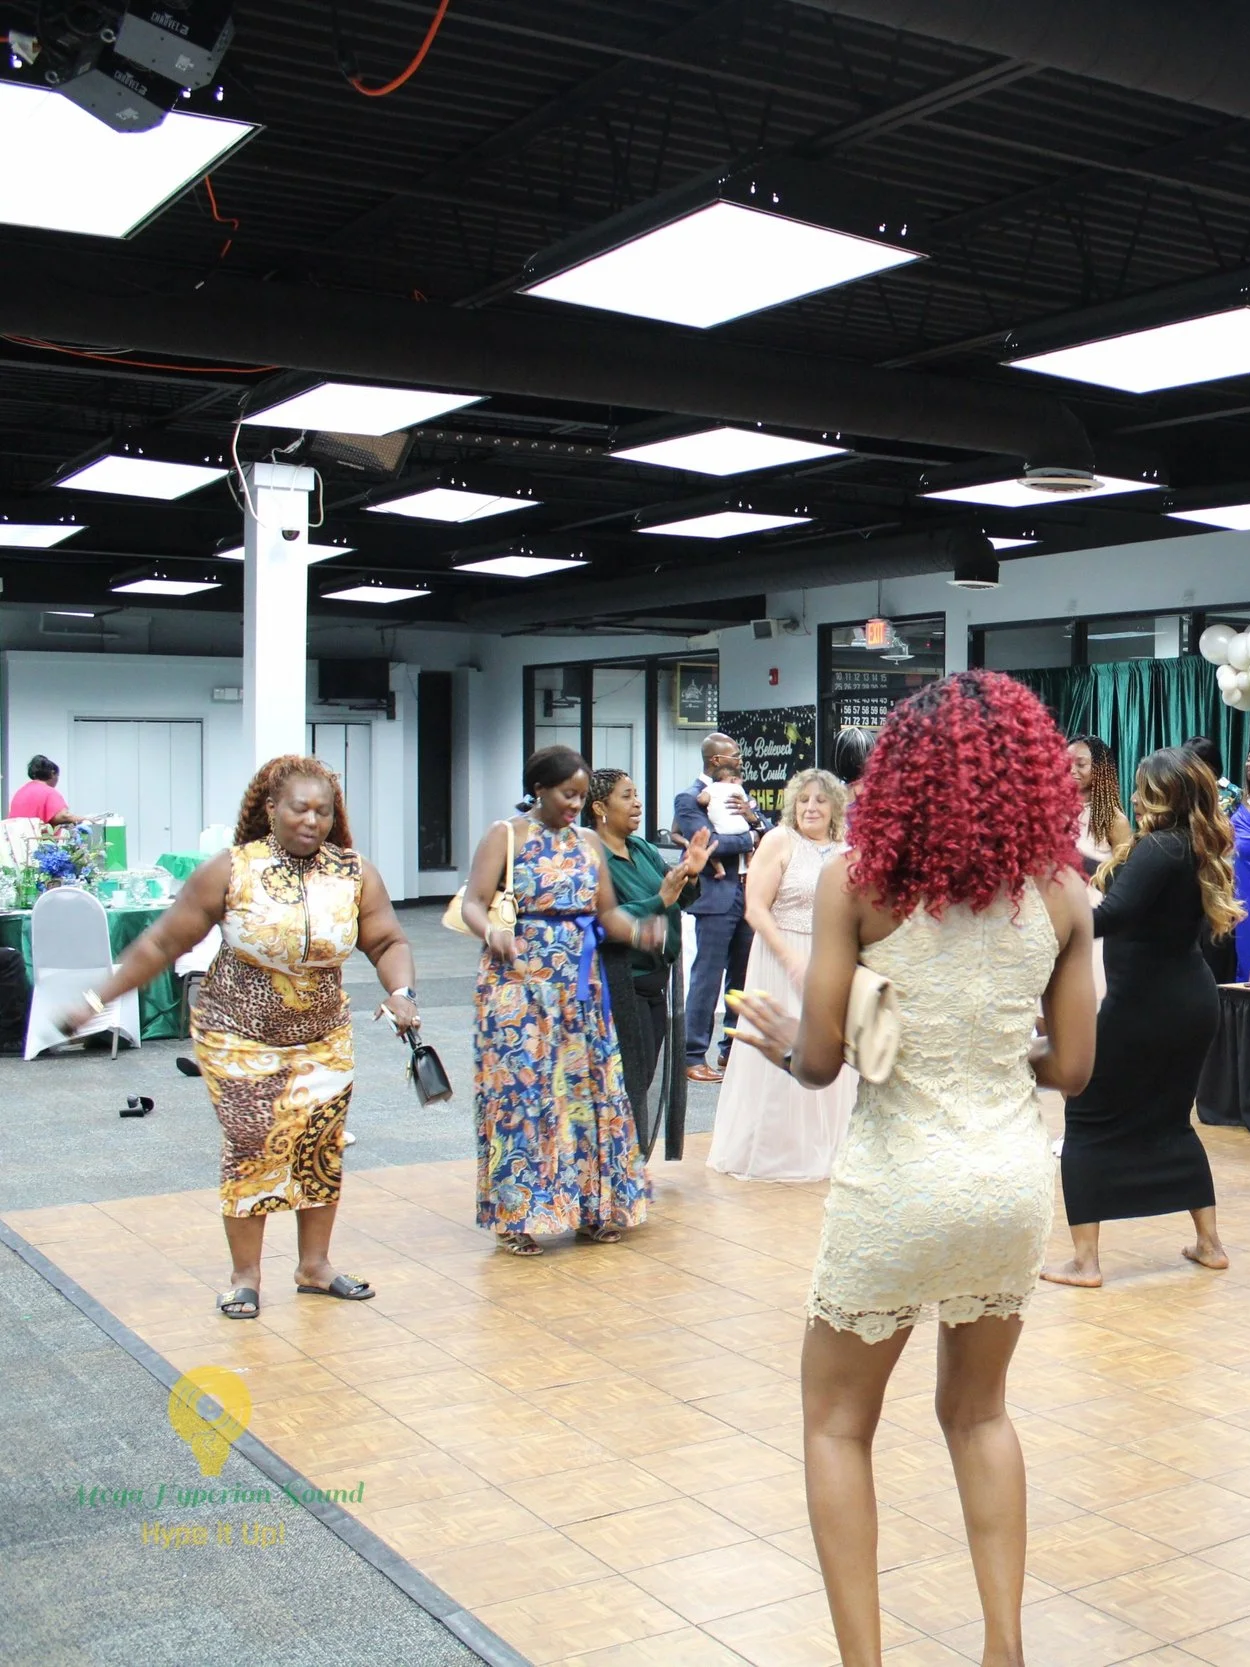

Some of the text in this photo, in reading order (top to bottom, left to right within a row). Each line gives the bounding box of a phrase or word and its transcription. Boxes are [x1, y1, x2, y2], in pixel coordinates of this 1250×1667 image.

[868, 623, 884, 644] EXIT
[845, 672, 851, 681] 11
[854, 672, 860, 681] 12
[862, 673, 870, 681] 13
[872, 673, 878, 682] 14
[880, 674, 887, 682] 15
[844, 706, 887, 714] 56 57 58 59 60
[844, 716, 887, 725] 71 72 73 74 75
[754, 736, 792, 758] Believed
[740, 761, 787, 782] She Could
[749, 789, 774, 811] SHE
